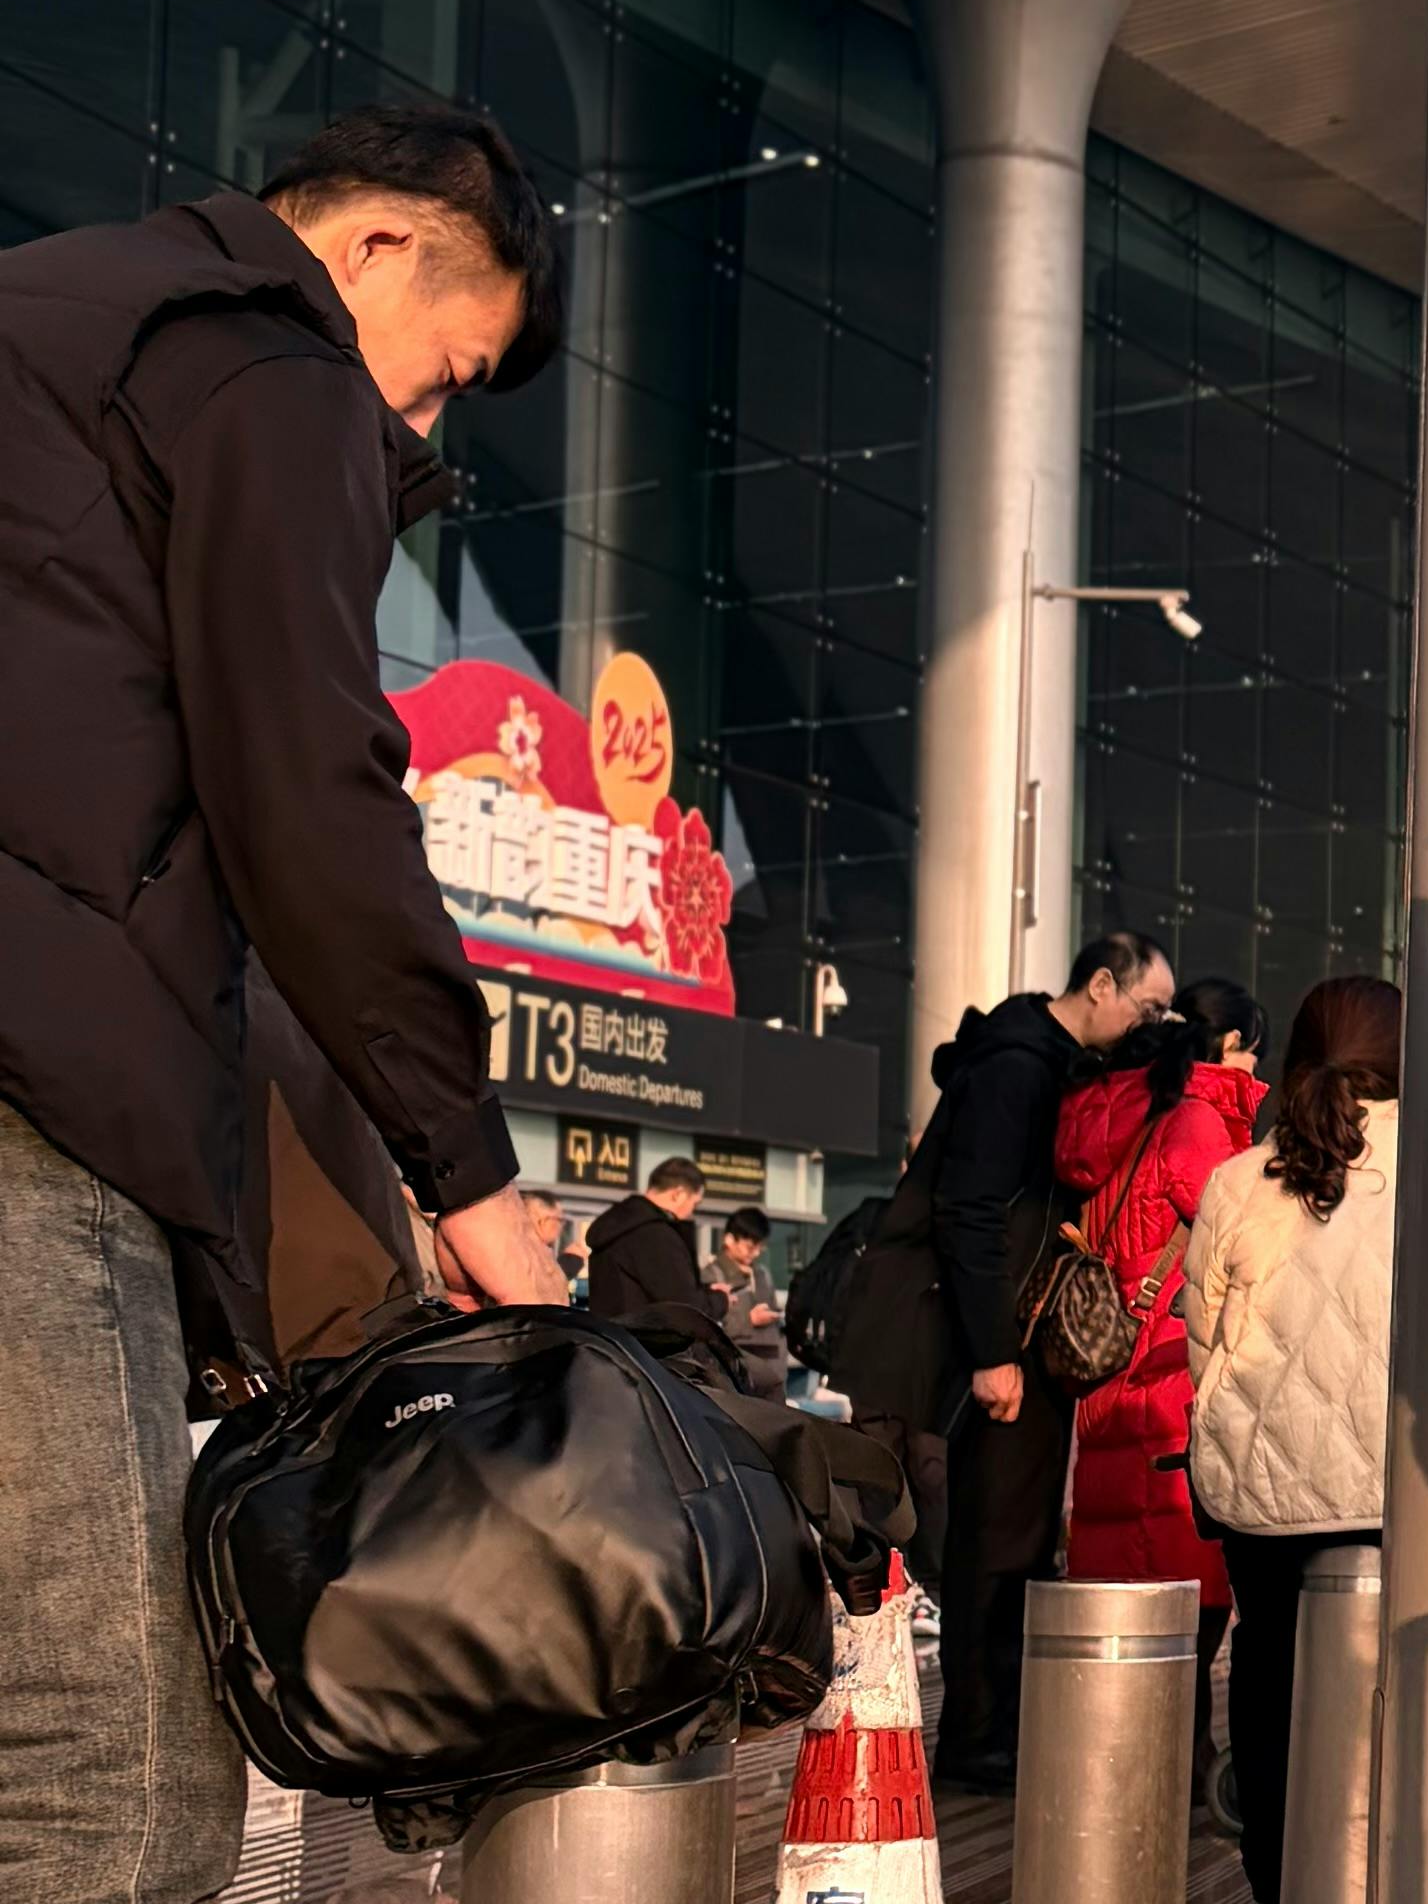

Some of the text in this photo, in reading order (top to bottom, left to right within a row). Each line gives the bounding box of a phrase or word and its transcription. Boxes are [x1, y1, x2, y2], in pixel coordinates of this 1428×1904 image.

[601, 698, 667, 784] 2025
[402, 766, 664, 938] 新韵重庆
[517, 991, 669, 1087] T3 国内出发
[578, 1063, 704, 1110] Domestic Departures
[597, 1132, 630, 1167] 入口
[384, 1392, 455, 1428] Jeep
